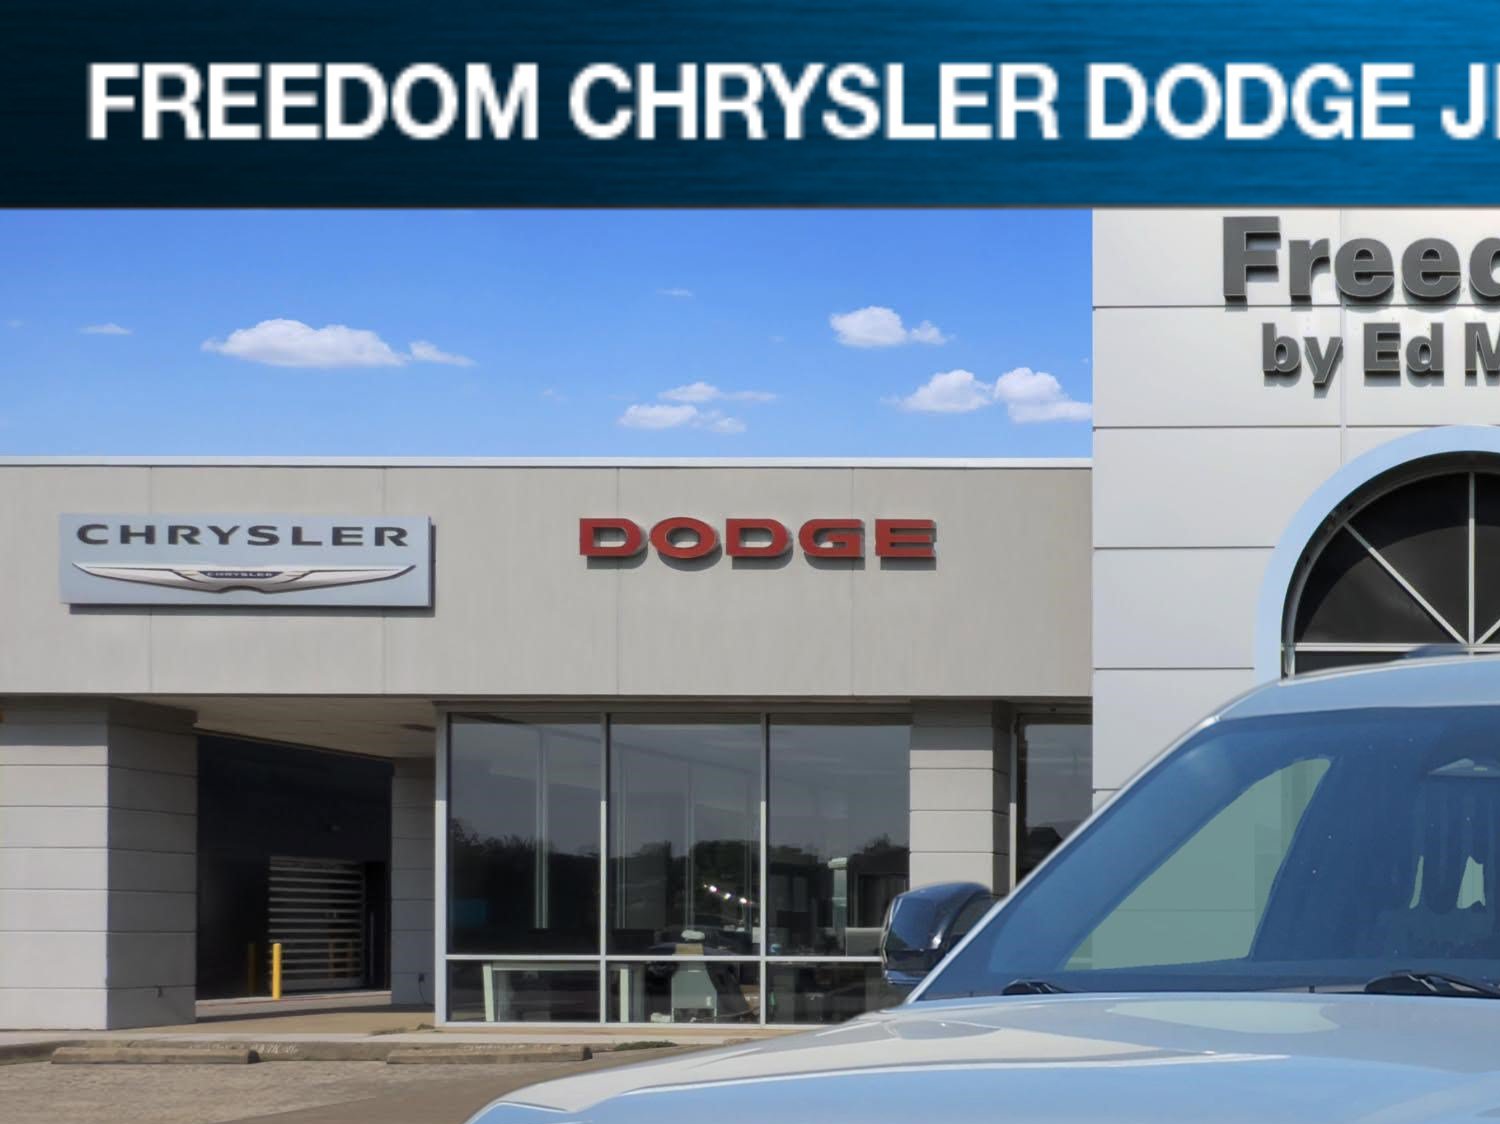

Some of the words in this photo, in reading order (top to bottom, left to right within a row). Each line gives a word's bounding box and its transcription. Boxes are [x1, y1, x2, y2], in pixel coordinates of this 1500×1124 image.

[1262, 322, 1343, 387] by
[1363, 322, 1444, 378] Ed
[76, 523, 409, 547] CHRYSLER
[579, 516, 935, 558] DODGE
